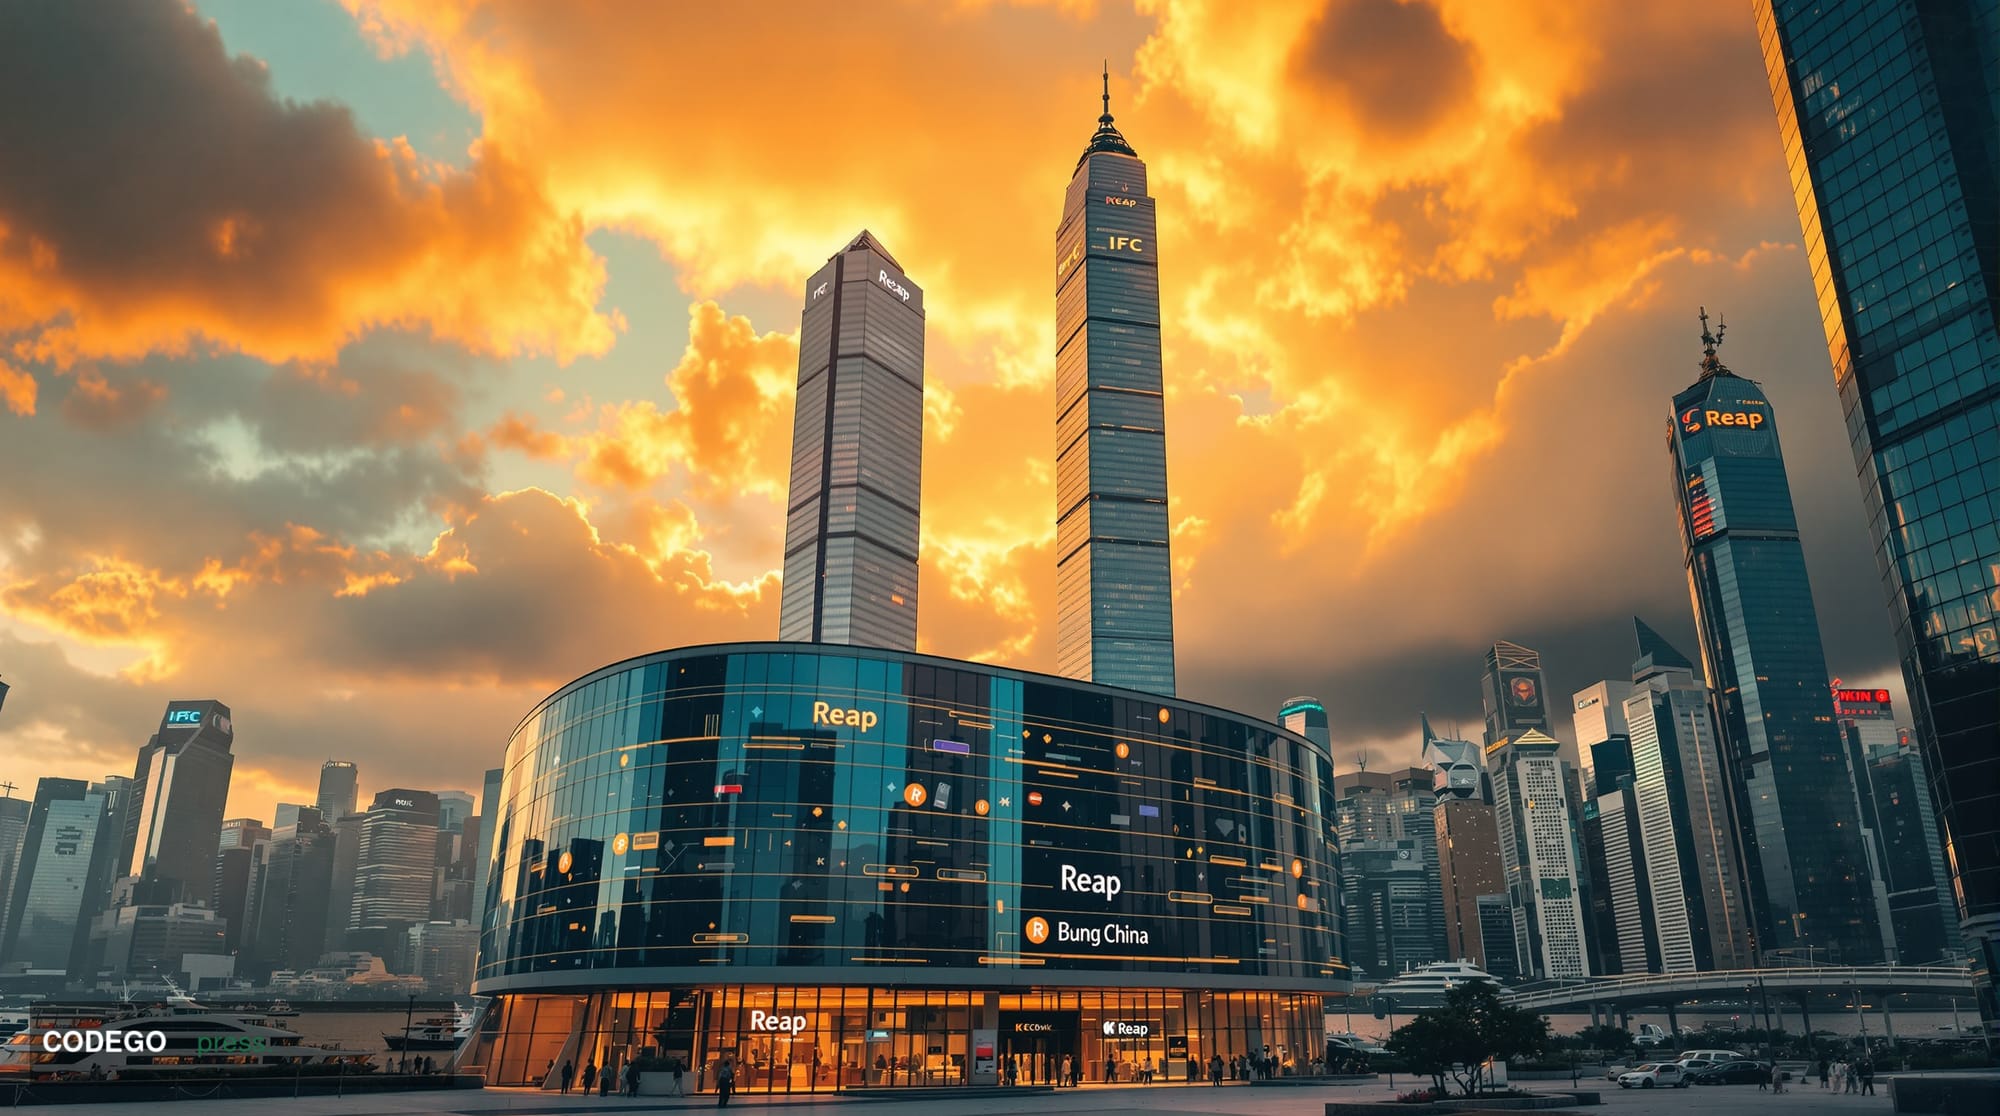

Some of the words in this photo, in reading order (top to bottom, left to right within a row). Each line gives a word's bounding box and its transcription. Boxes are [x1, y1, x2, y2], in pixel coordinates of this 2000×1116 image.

[1109, 236, 1143, 252] IFC
[1705, 410, 1763, 430] Reap
[813, 701, 878, 733] Reap
[1061, 864, 1121, 901] Reap
[1058, 921, 1100, 947] Bung
[1104, 924, 1149, 945] China
[751, 1010, 807, 1036] Reap
[1118, 1022, 1148, 1037] Reap
